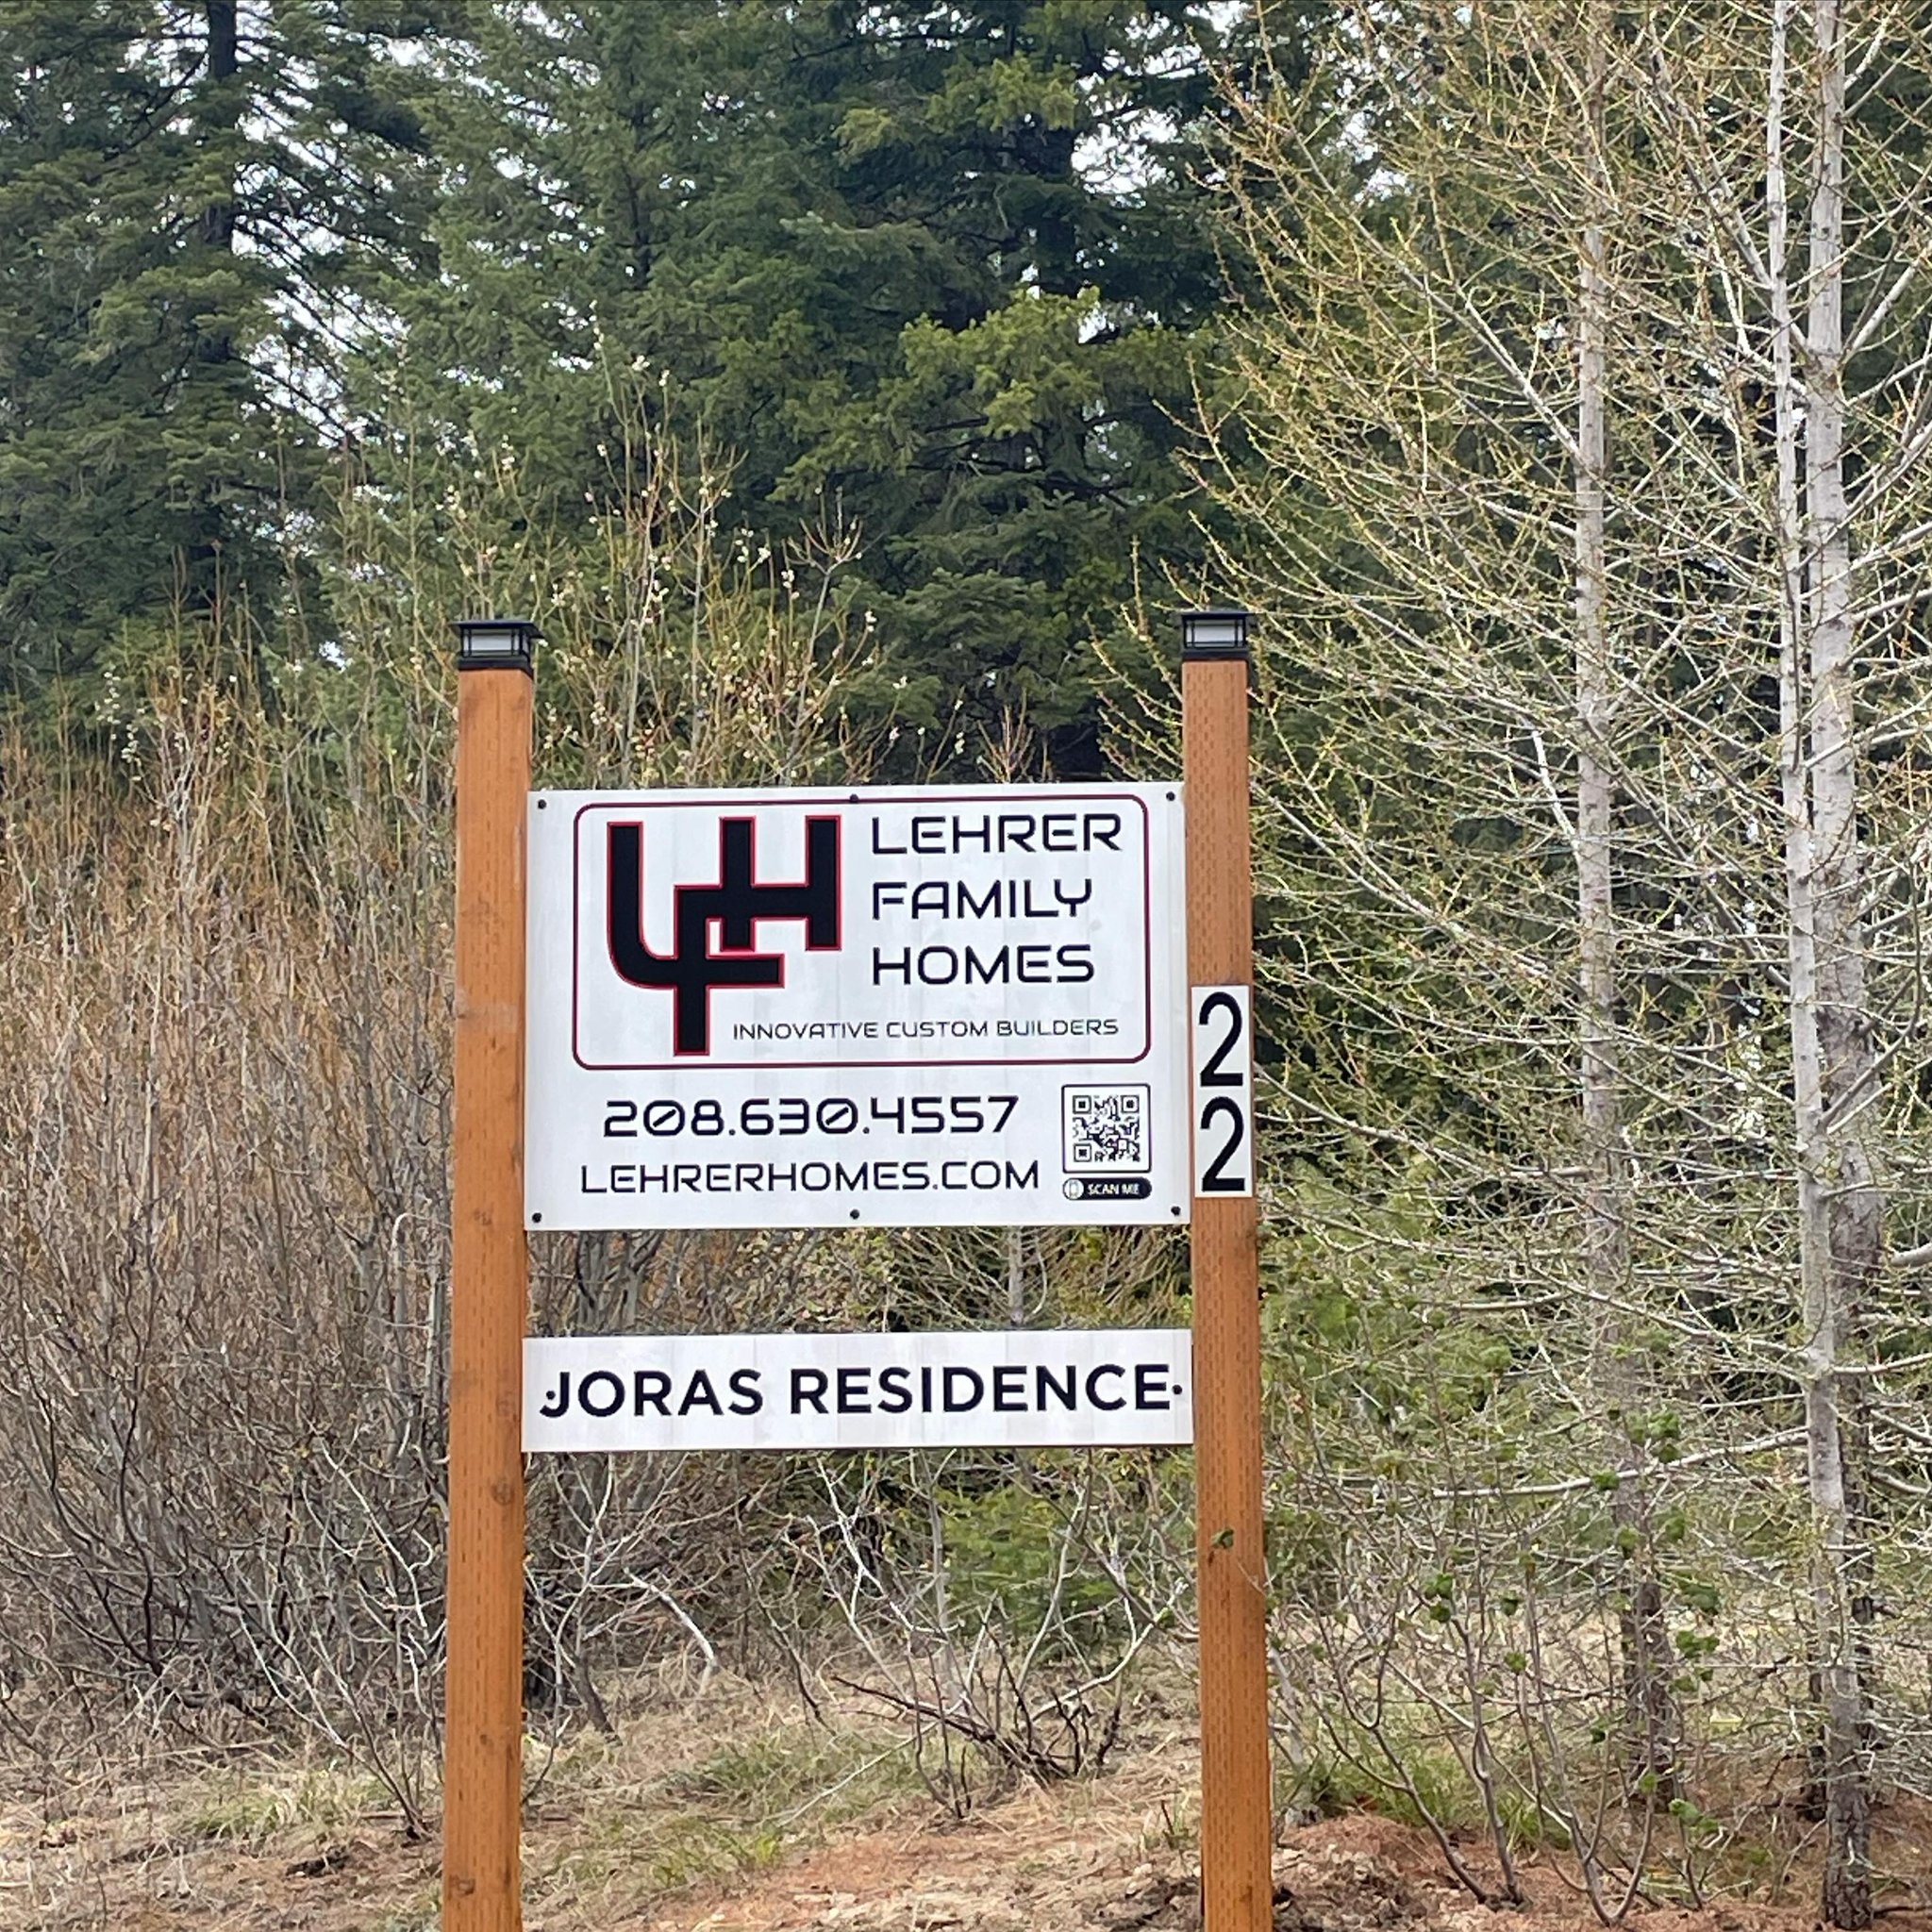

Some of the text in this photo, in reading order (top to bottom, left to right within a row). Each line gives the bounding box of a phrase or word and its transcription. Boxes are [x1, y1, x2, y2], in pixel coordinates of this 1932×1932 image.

[873, 814, 1121, 854] LEHRER
[873, 879, 1091, 920] FAMILY
[874, 944, 1094, 985] HOMES
[734, 1020, 1118, 1039] INNOVATIVE CUSTOM BUILDERS
[604, 1096, 1018, 1137] 208.630.4557
[582, 1160, 1038, 1192] LEHRERHOMES.COM
[1088, 1183, 1140, 1195] SCAN ME
[540, 1364, 1170, 1418] JORAS RESIDENCE
